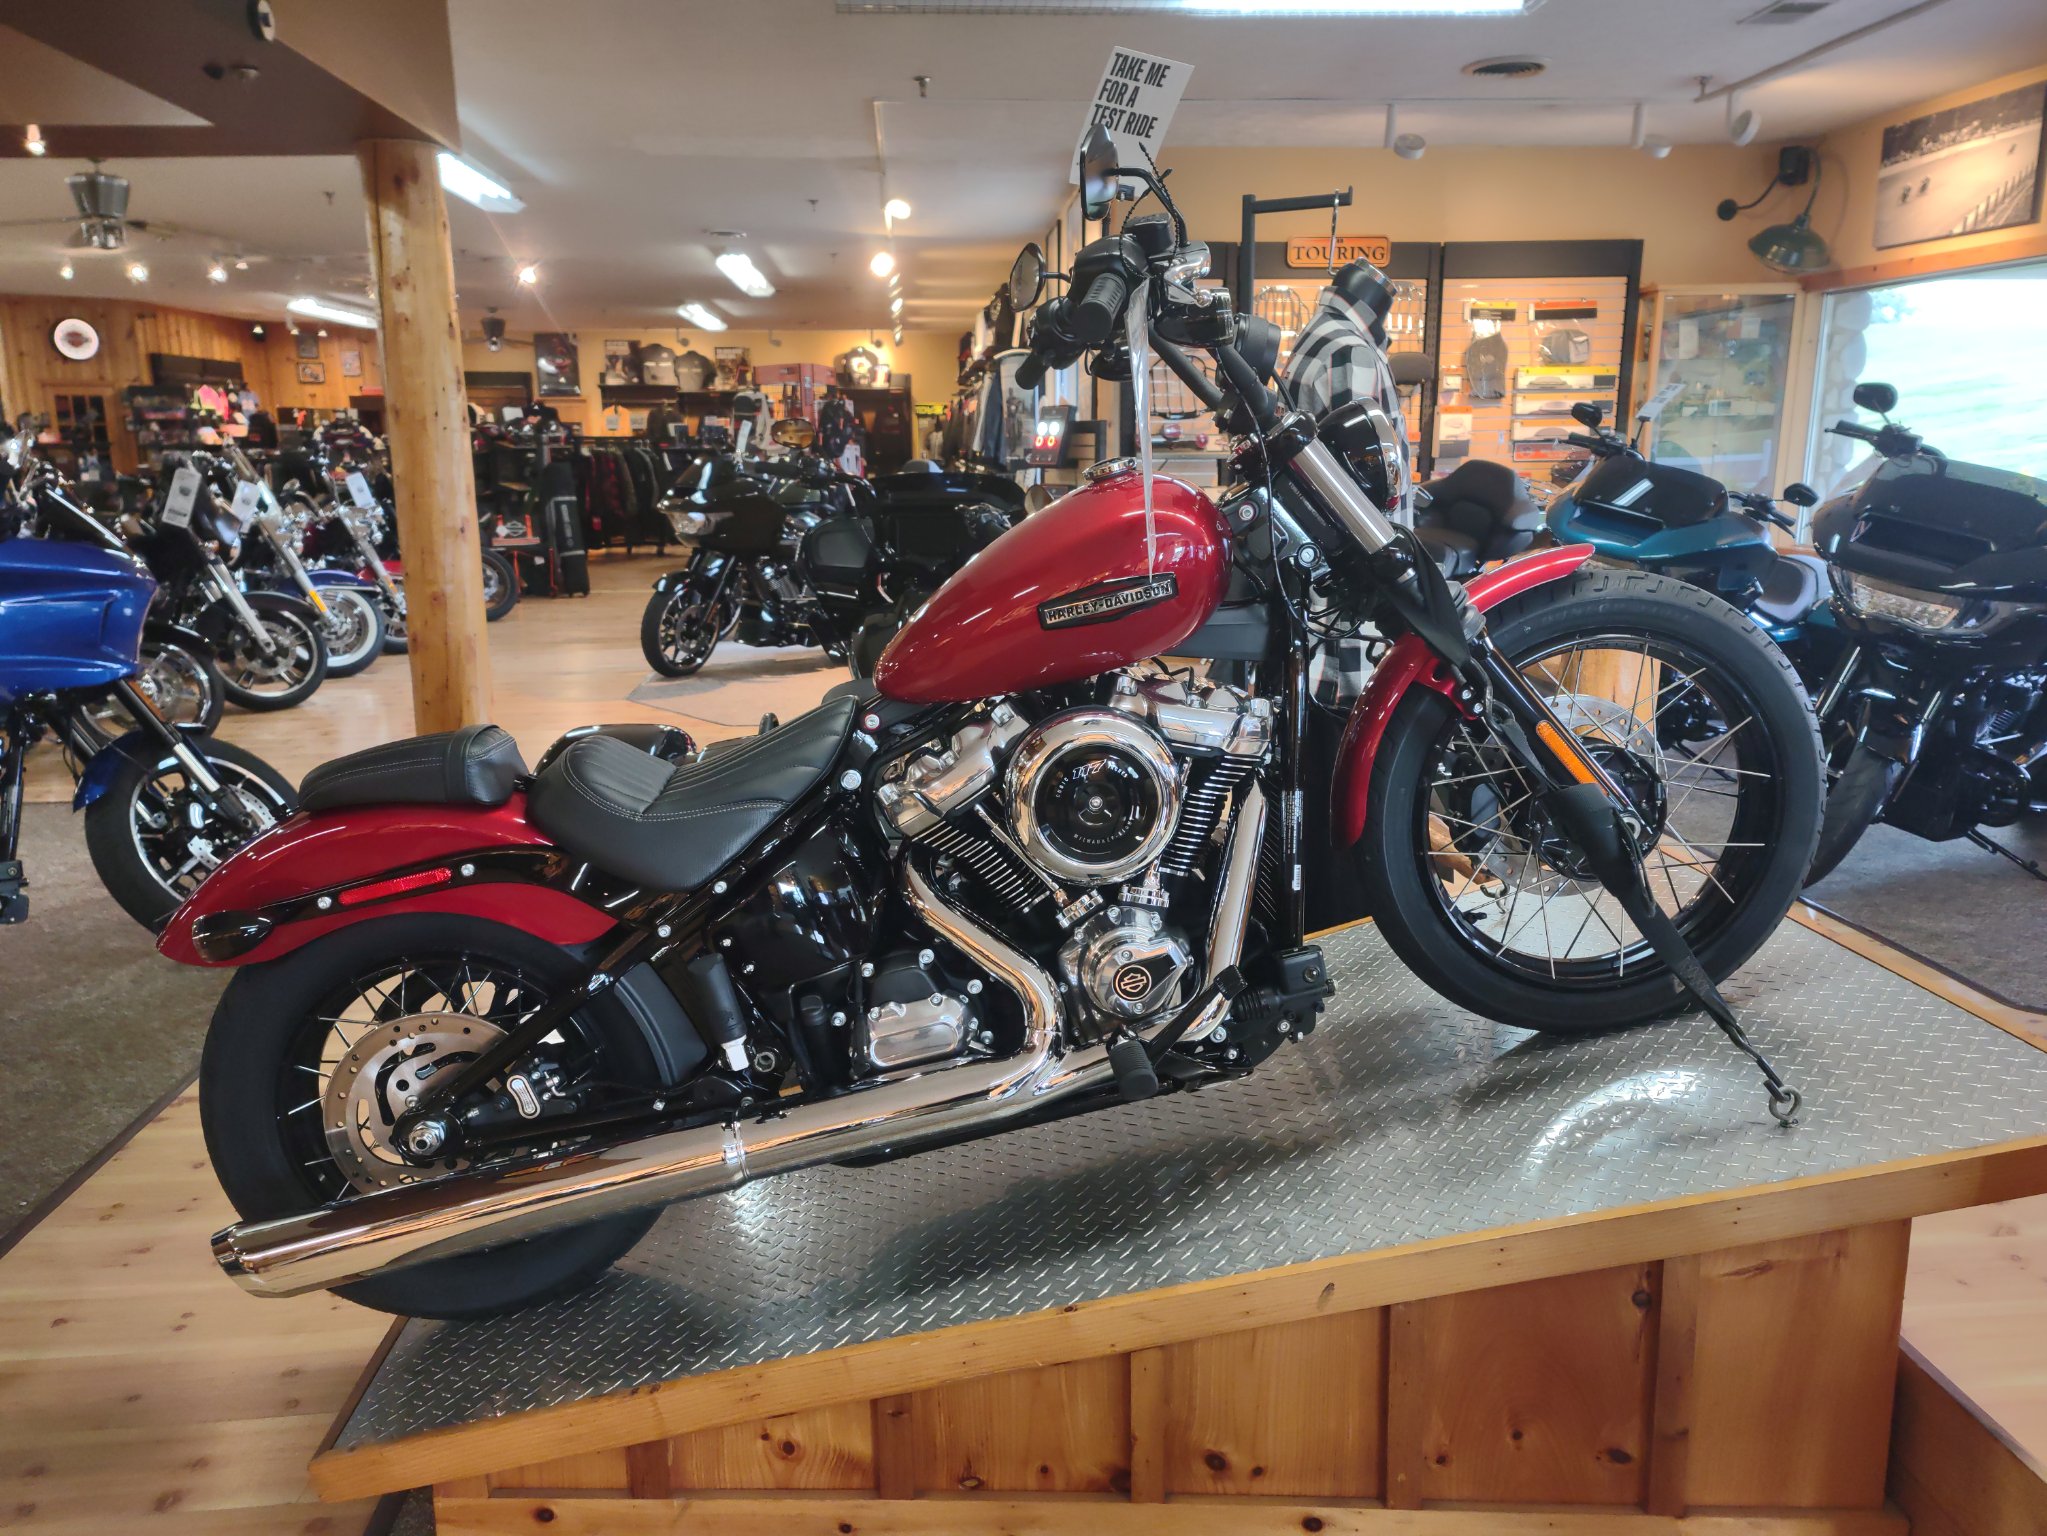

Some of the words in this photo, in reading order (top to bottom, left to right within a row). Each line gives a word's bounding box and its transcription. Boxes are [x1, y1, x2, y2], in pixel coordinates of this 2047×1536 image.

[1110, 52, 1148, 82] TAKE
[1144, 62, 1171, 88] ME
[1098, 78, 1129, 105] FOR
[1126, 86, 1141, 108] A
[1091, 103, 1127, 131] TEST
[1122, 112, 1159, 139] RIDE
[1293, 246, 1386, 261] TOURING
[1048, 580, 1172, 622] HARLEY-DAVIDSON
